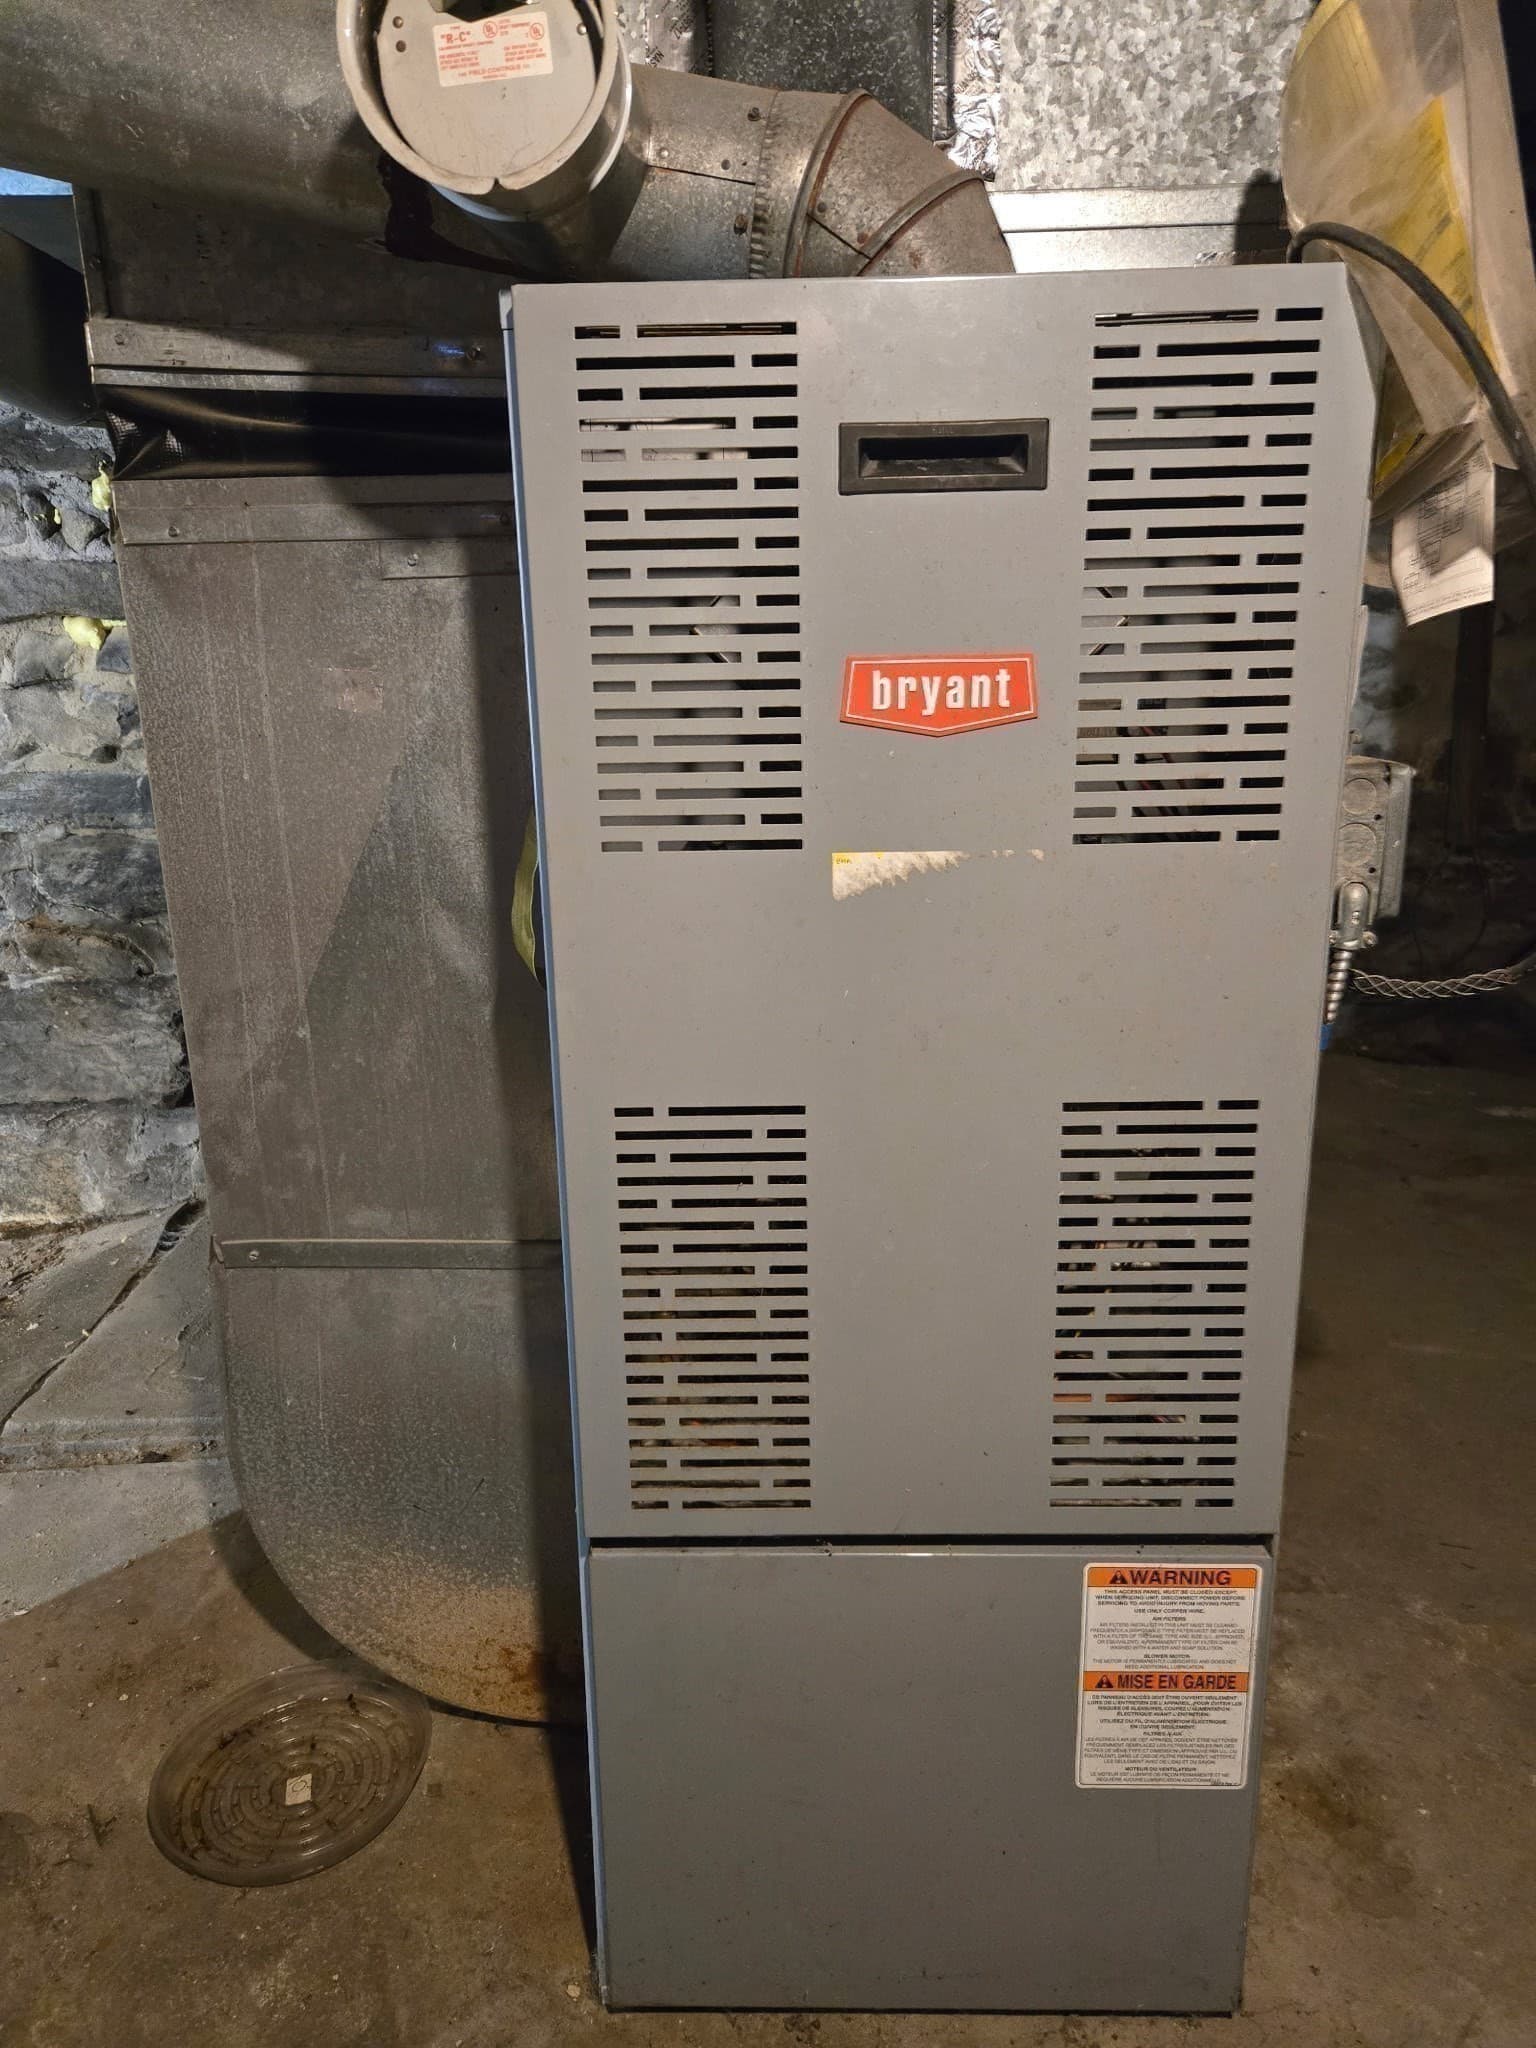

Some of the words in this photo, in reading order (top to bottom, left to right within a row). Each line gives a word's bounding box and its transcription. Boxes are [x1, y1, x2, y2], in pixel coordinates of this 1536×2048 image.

[871, 668, 1011, 716] bryant
[1128, 1570, 1231, 1585] WARNING
[1118, 1675, 1154, 1689] MISE
[1158, 1675, 1179, 1689] EN
[1183, 1675, 1236, 1689] GARDE
